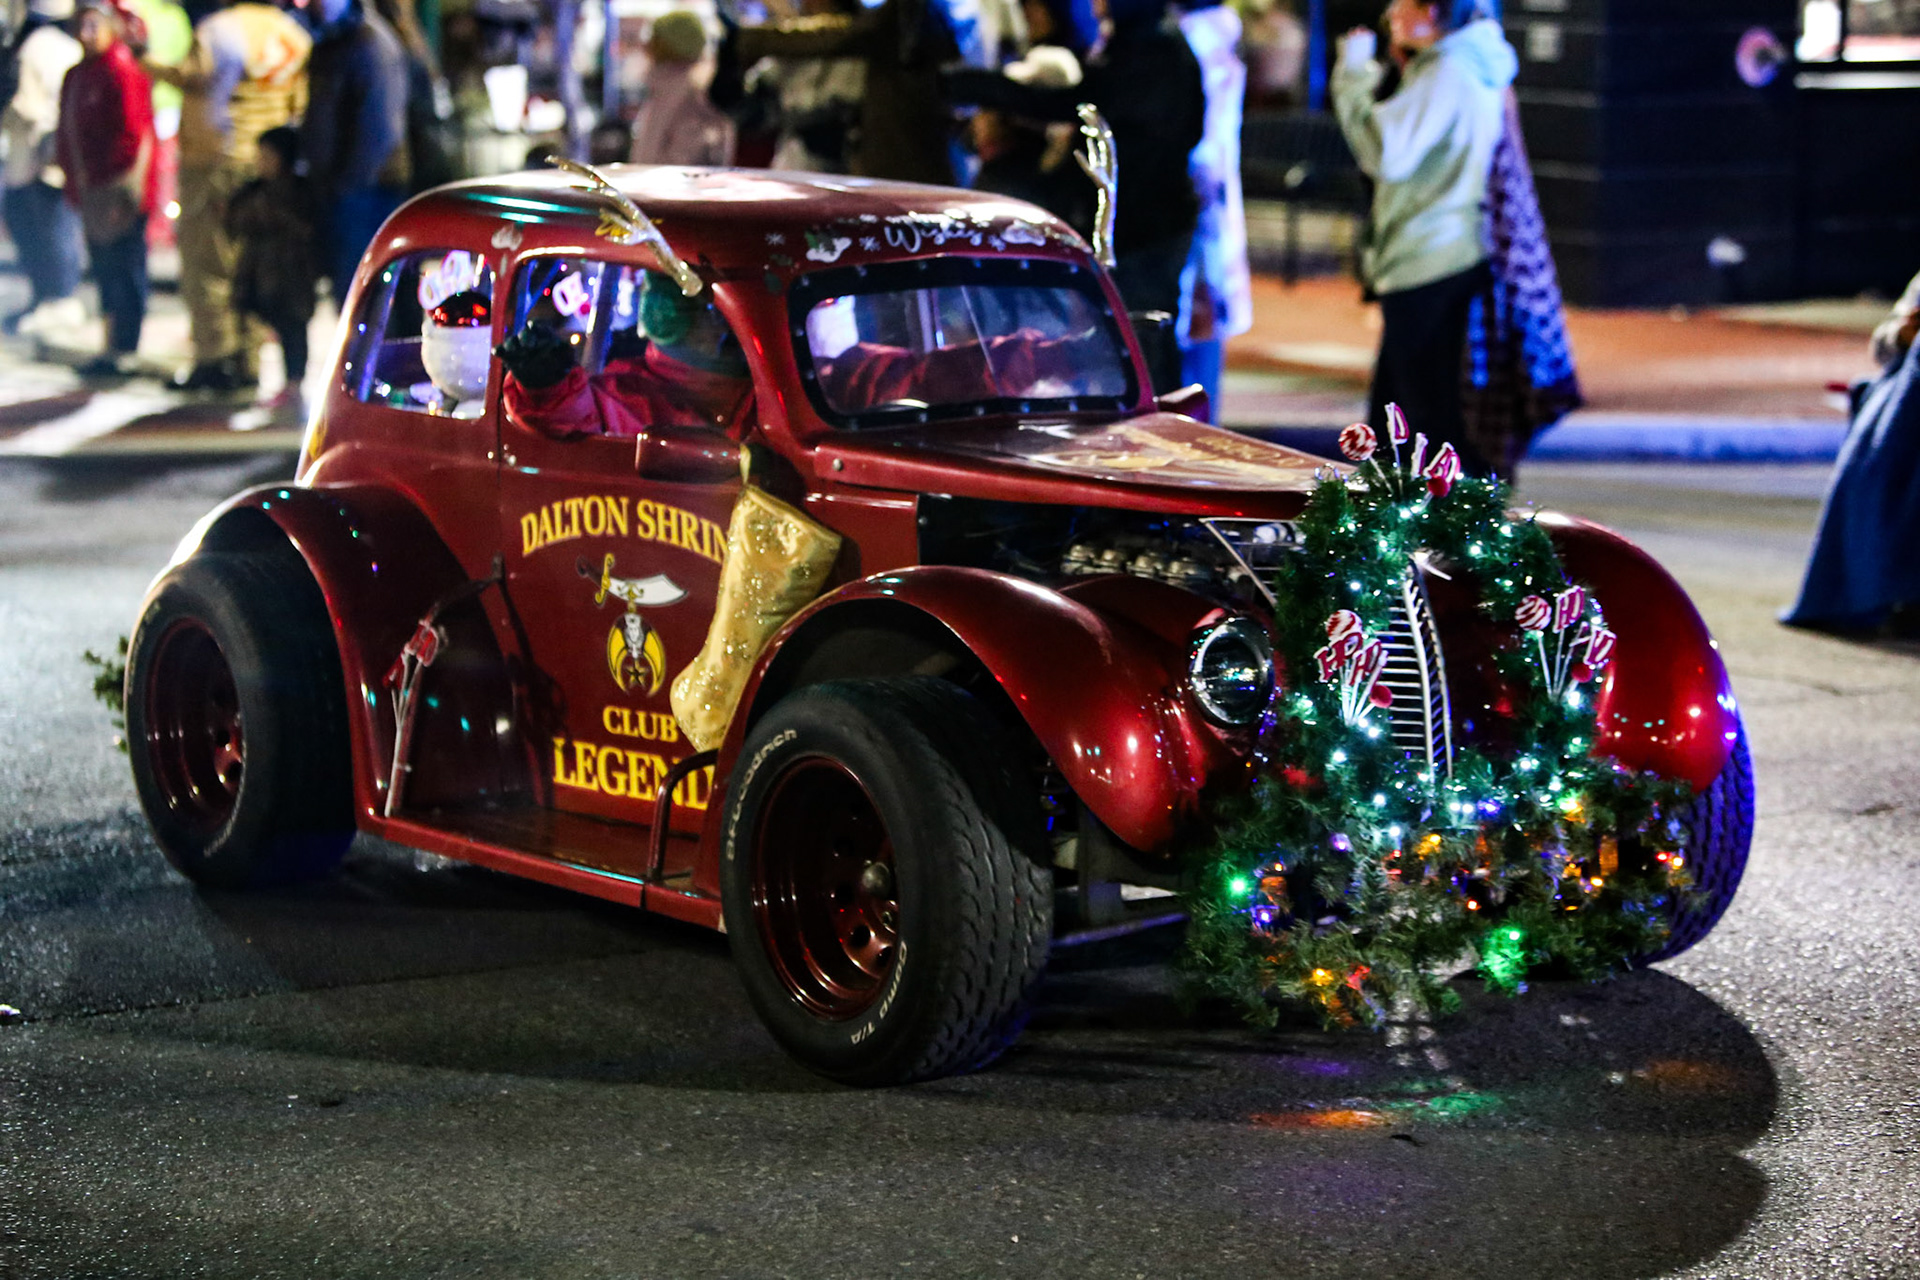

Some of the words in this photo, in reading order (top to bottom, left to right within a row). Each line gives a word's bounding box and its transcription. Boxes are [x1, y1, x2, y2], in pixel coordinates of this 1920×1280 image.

[520, 495, 629, 557] DALTON
[636, 499, 729, 564] SHRIN
[603, 705, 679, 743] CLUB
